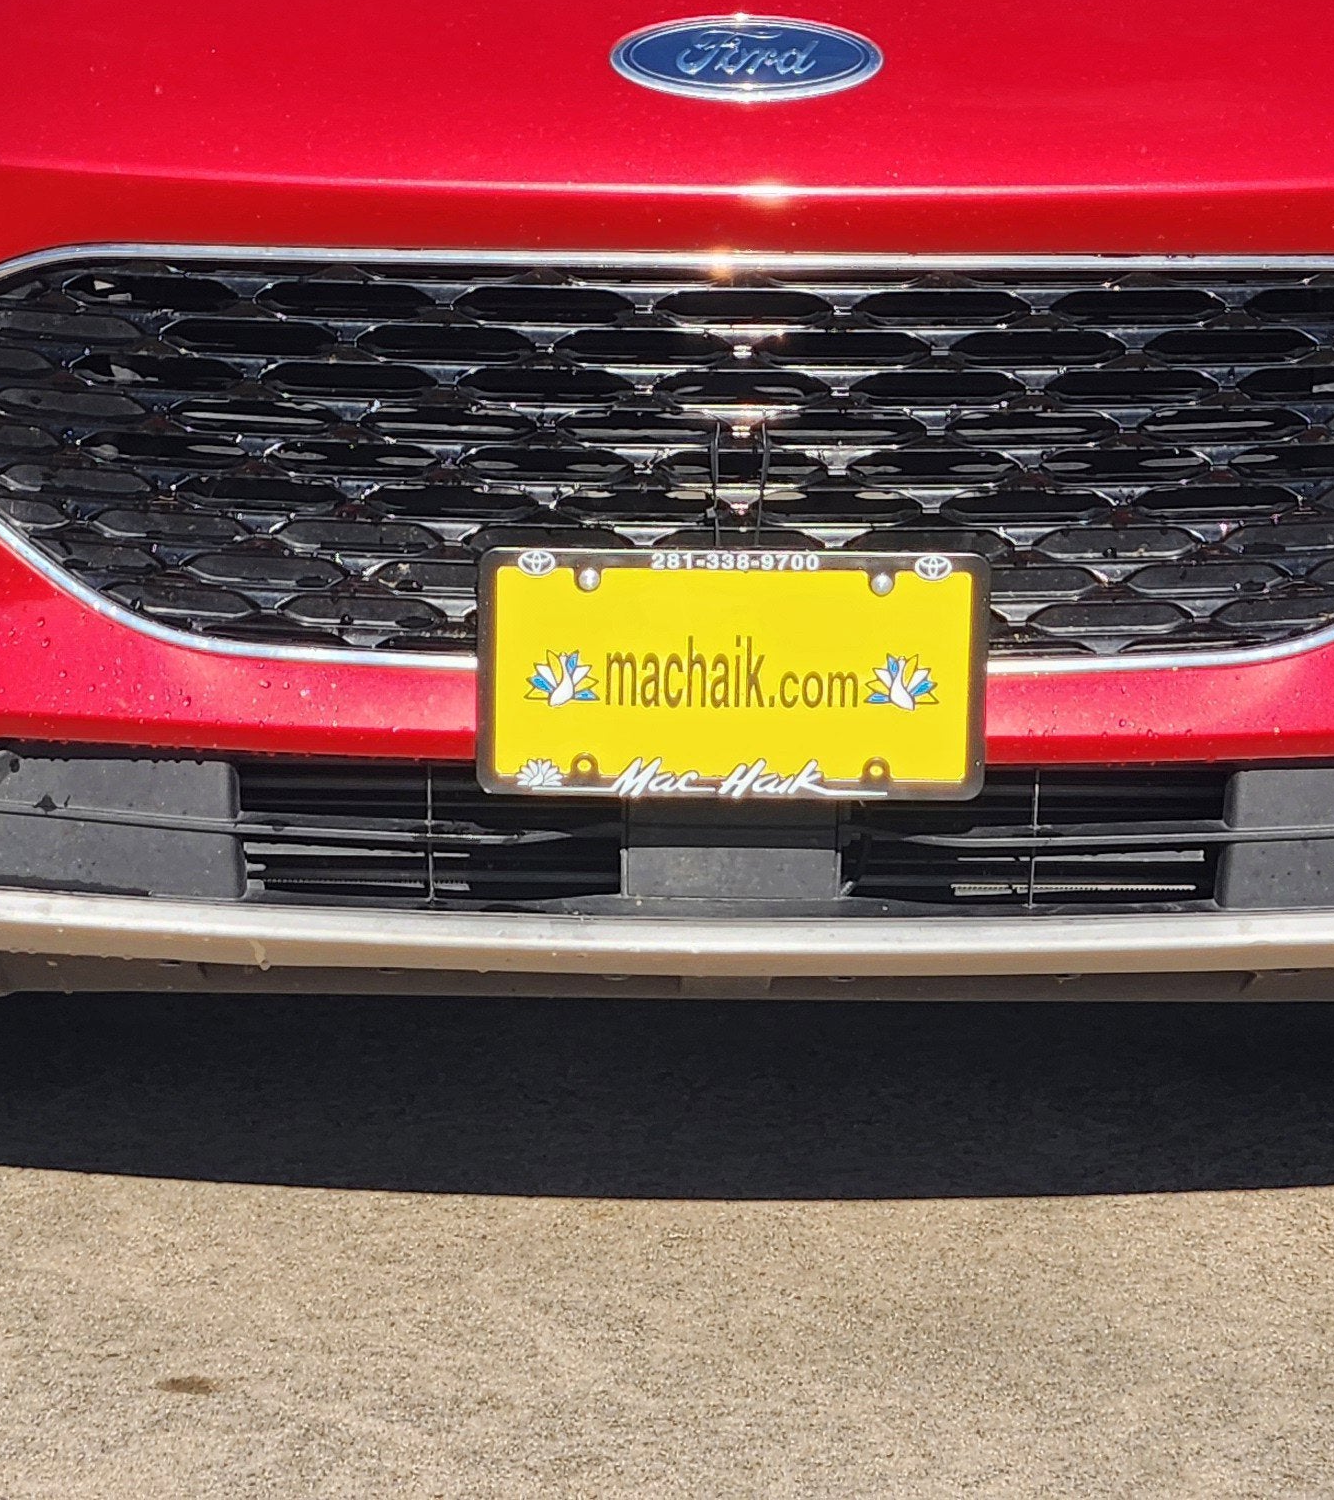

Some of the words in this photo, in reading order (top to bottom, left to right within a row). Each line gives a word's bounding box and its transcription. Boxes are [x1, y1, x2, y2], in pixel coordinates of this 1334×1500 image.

[676, 29, 819, 75] Ford
[651, 553, 819, 571] 281-338-9700
[605, 634, 859, 708] machaik.com
[611, 756, 717, 798] Mac
[717, 757, 824, 798] Haik
